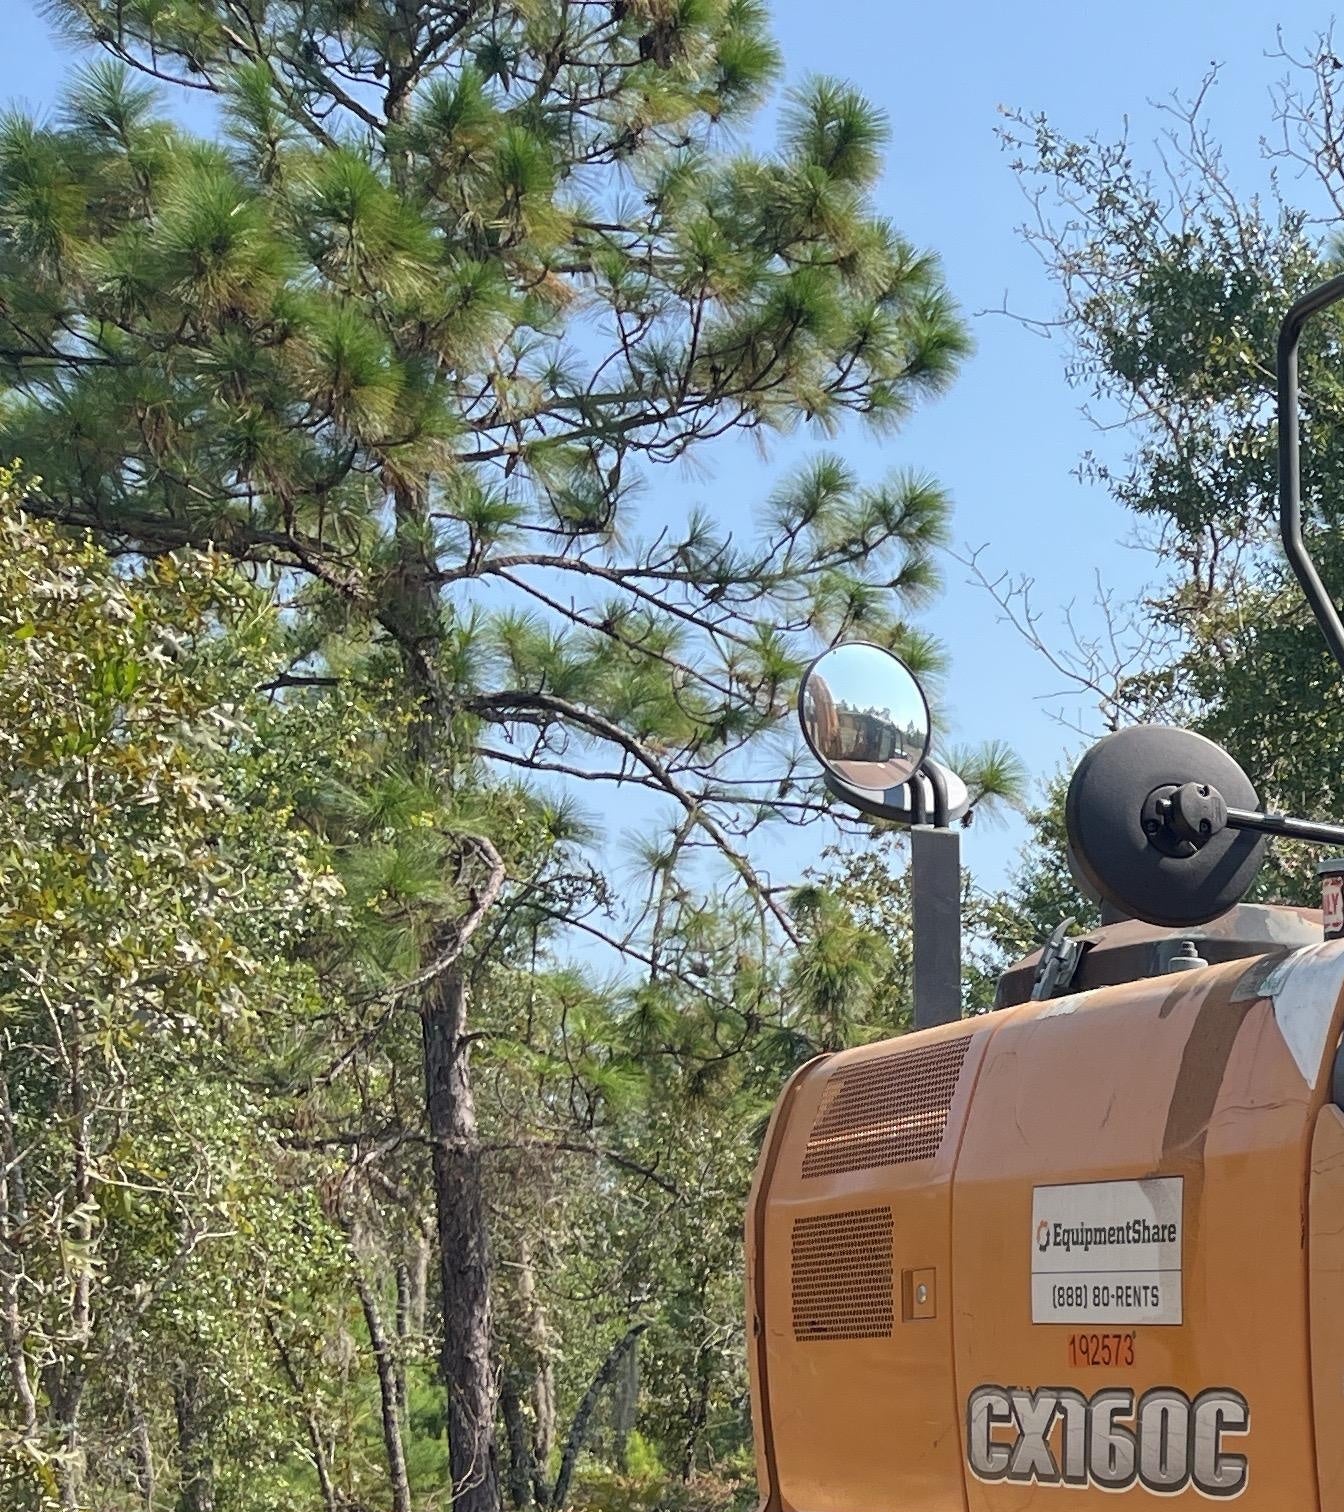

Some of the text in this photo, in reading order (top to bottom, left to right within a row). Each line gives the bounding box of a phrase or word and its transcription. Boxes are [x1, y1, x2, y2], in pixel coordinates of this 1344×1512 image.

[1053, 1218, 1177, 1252] EquipmentShare
[1052, 1284, 1088, 1309] (888)
[1068, 1333, 1135, 1367] 192573
[966, 1383, 1251, 1501] CX160C
